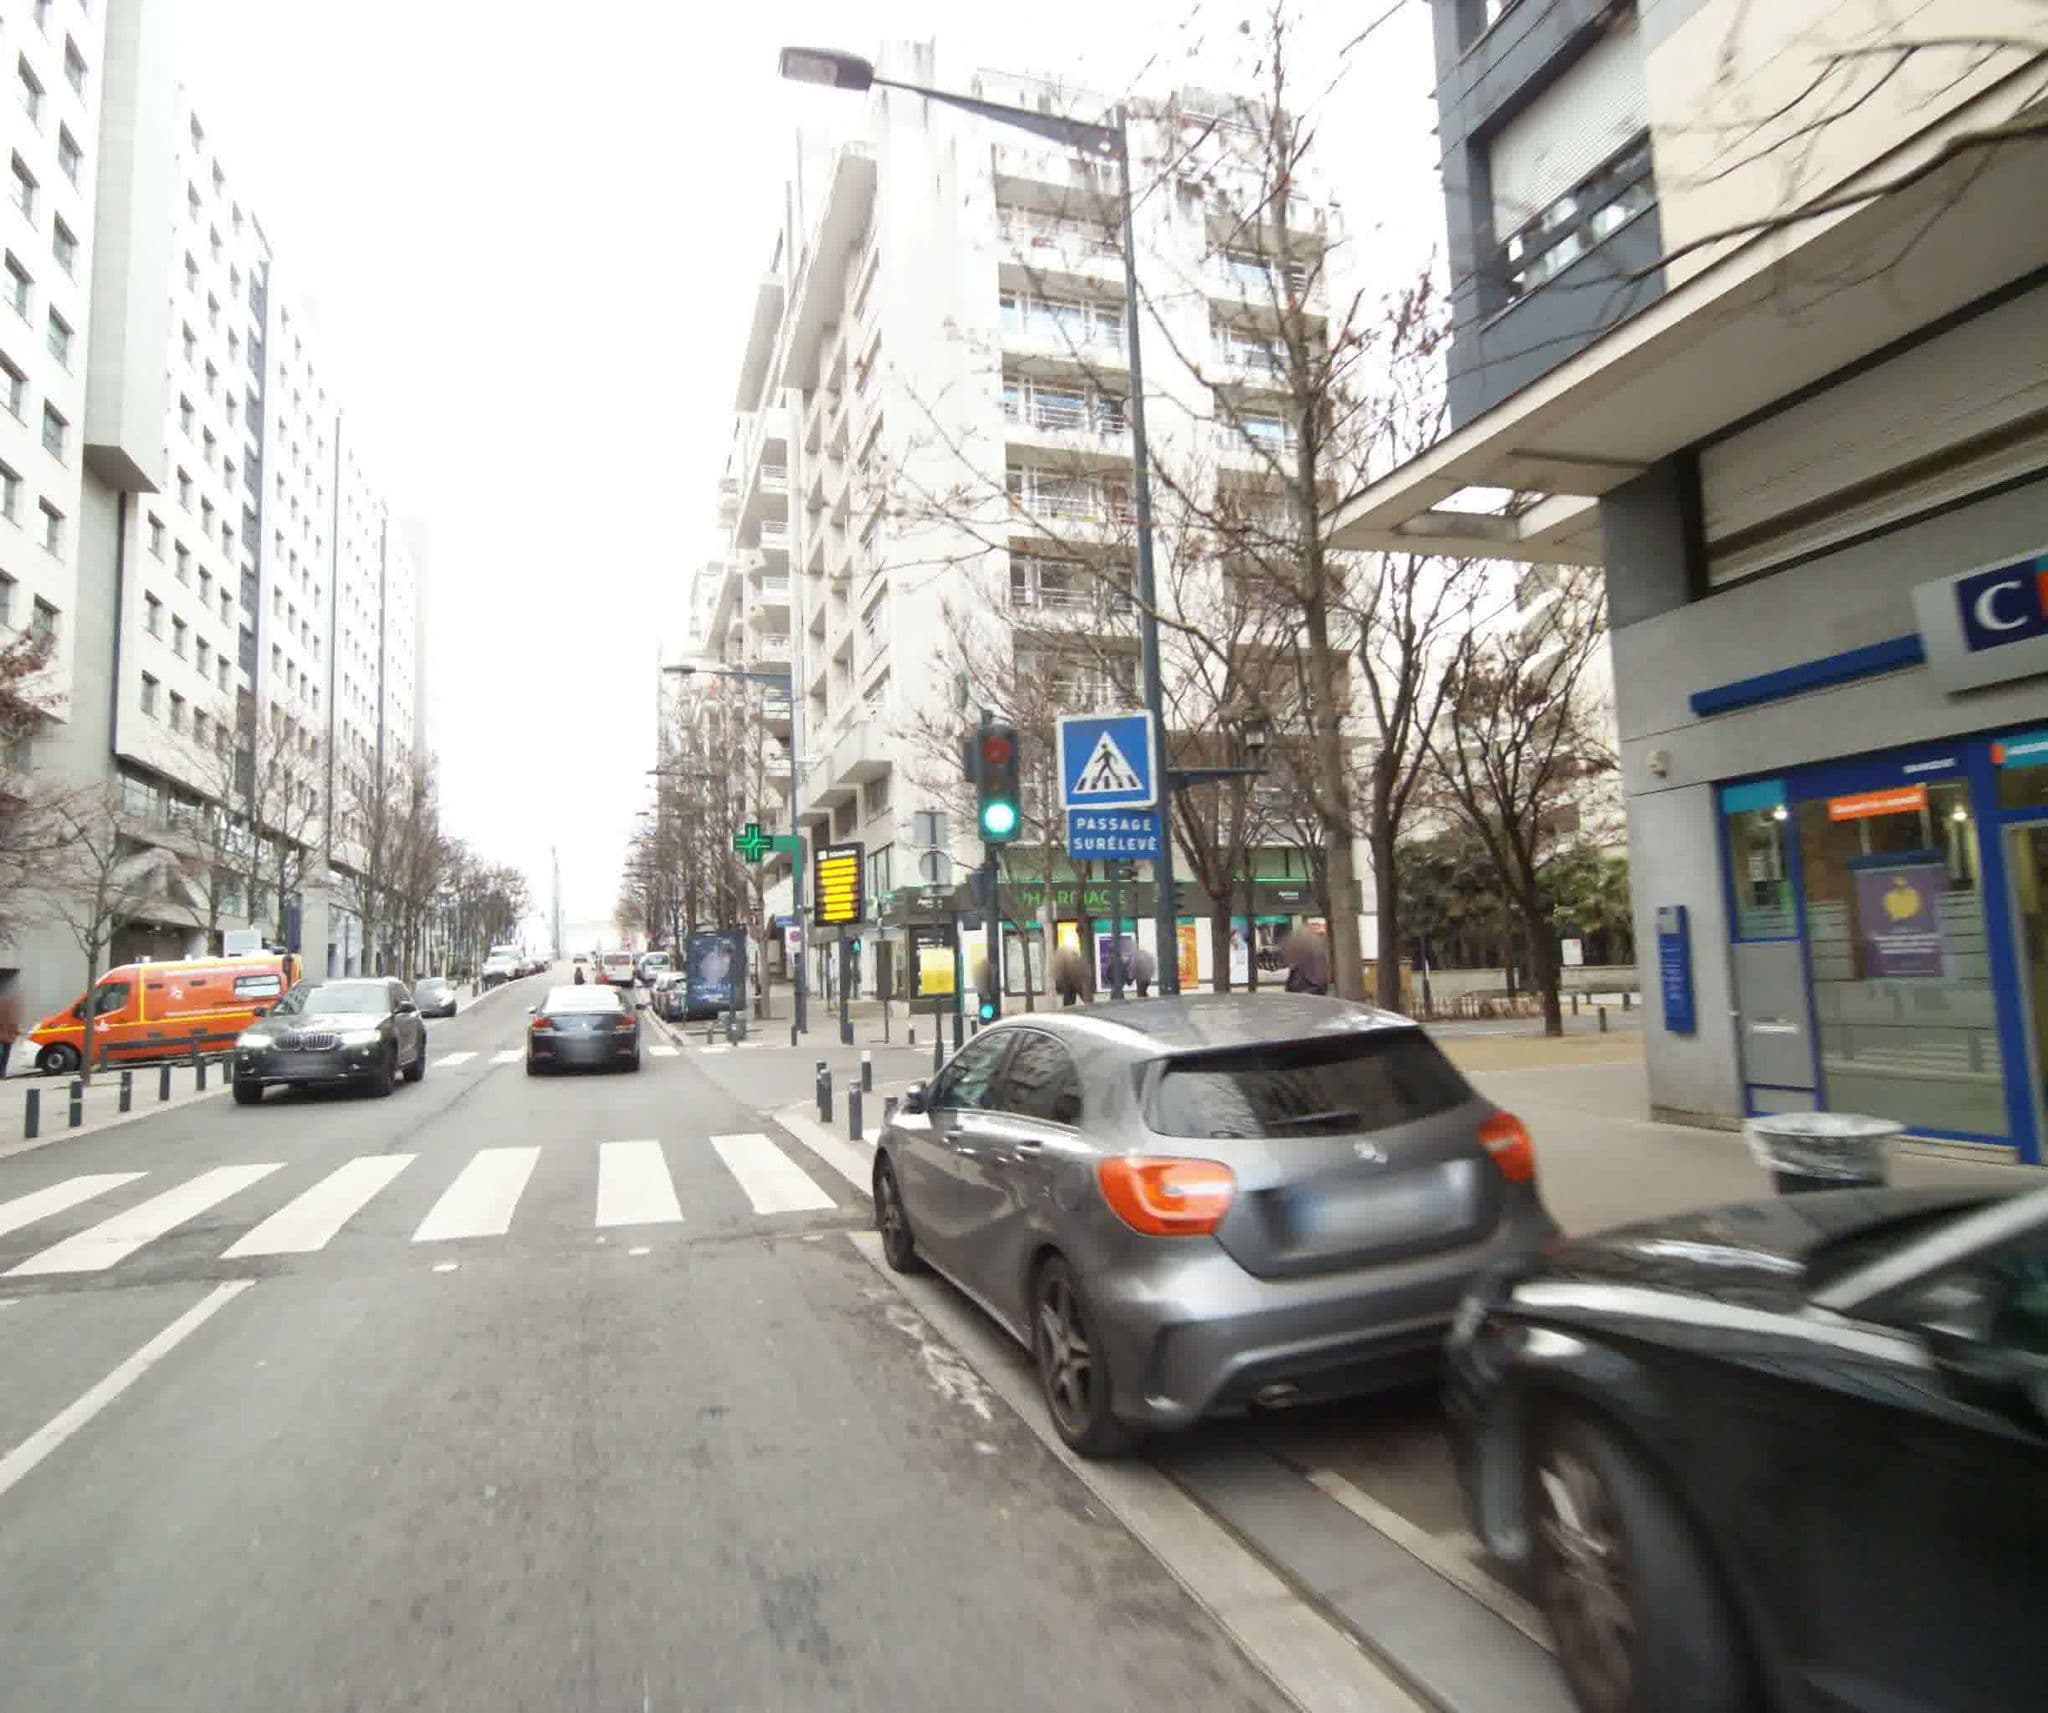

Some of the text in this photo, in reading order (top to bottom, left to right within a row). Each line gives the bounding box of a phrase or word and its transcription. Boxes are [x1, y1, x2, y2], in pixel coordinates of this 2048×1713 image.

[1076, 817, 1152, 831] PASSAGE
[1073, 835, 1157, 851] SURÉLEVÉ
[1021, 888, 1126, 905] PHRMACE
